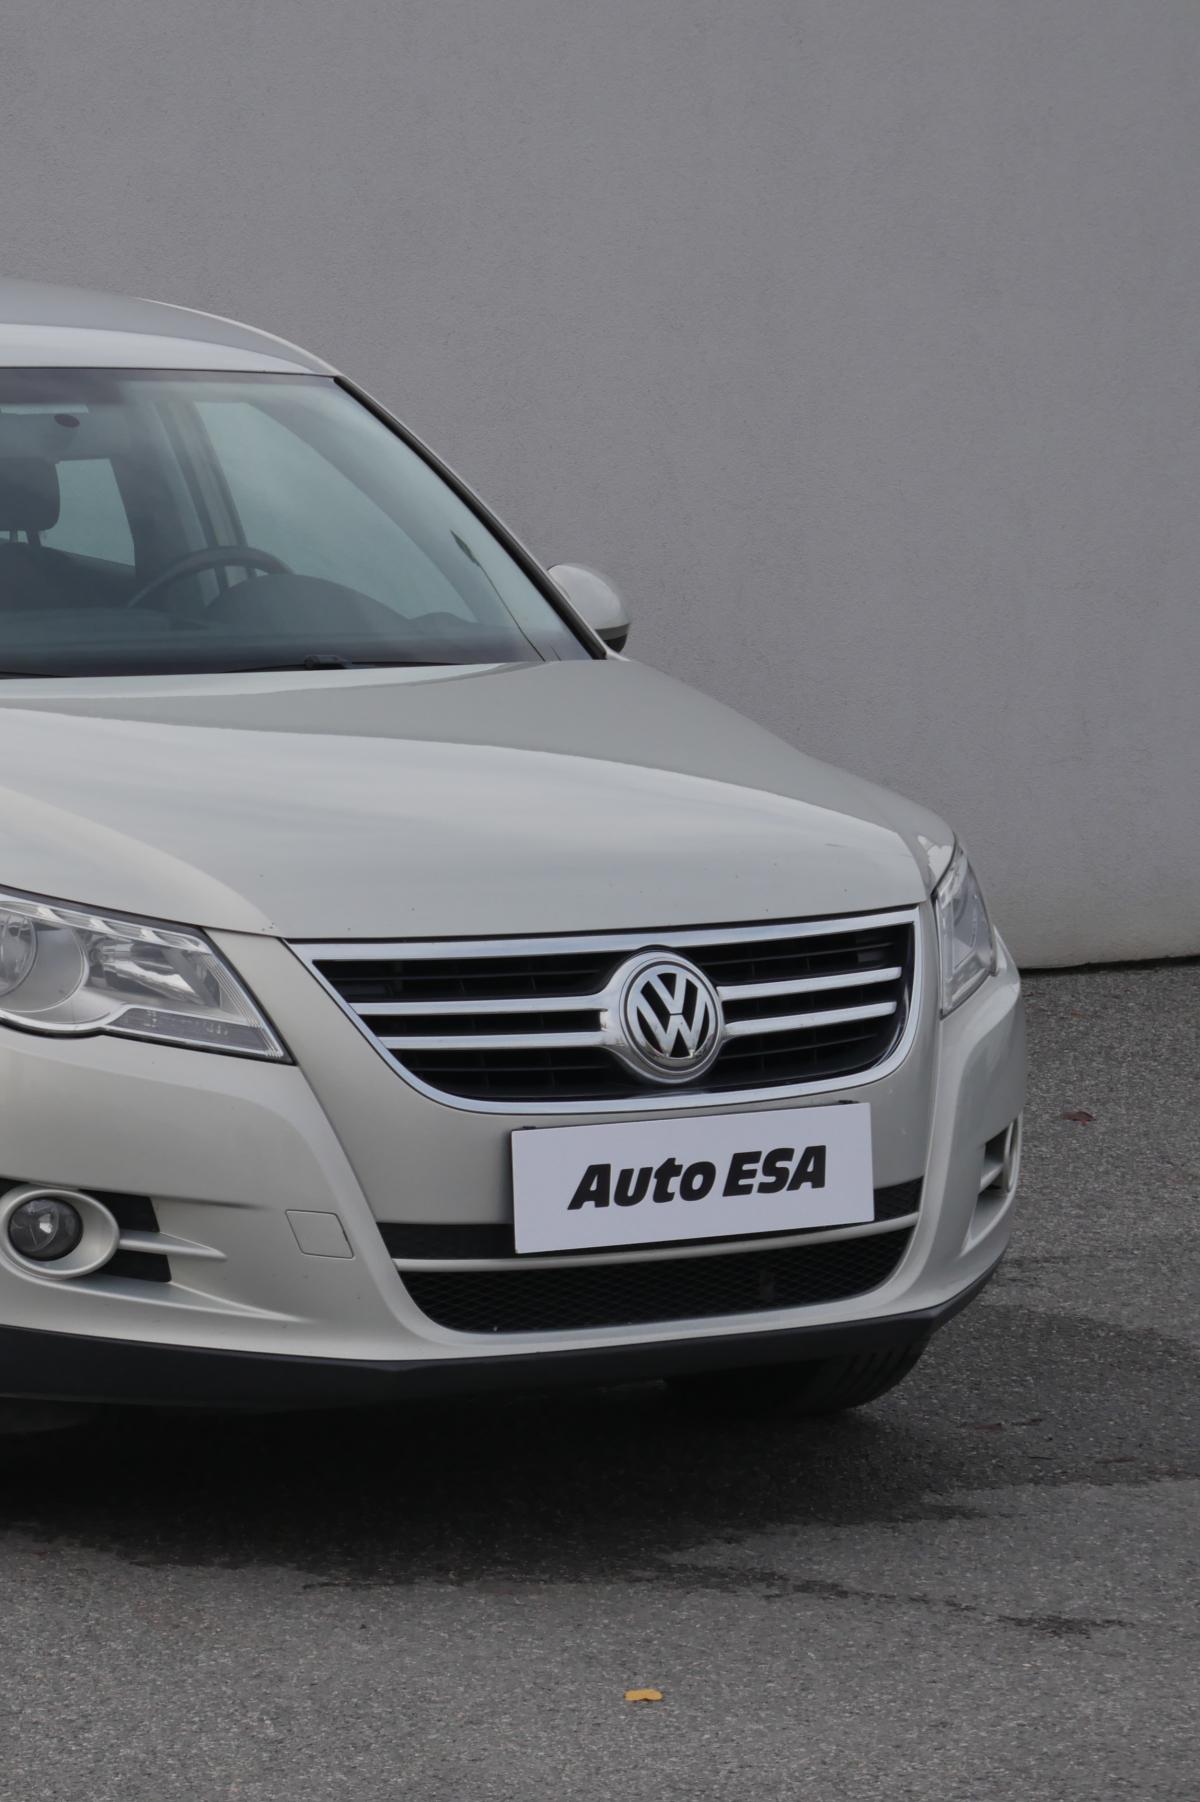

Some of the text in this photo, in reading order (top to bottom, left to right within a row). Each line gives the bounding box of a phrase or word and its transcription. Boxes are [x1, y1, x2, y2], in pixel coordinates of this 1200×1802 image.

[630, 965, 714, 1066] VW
[566, 1144, 827, 1211] Auto ESA
